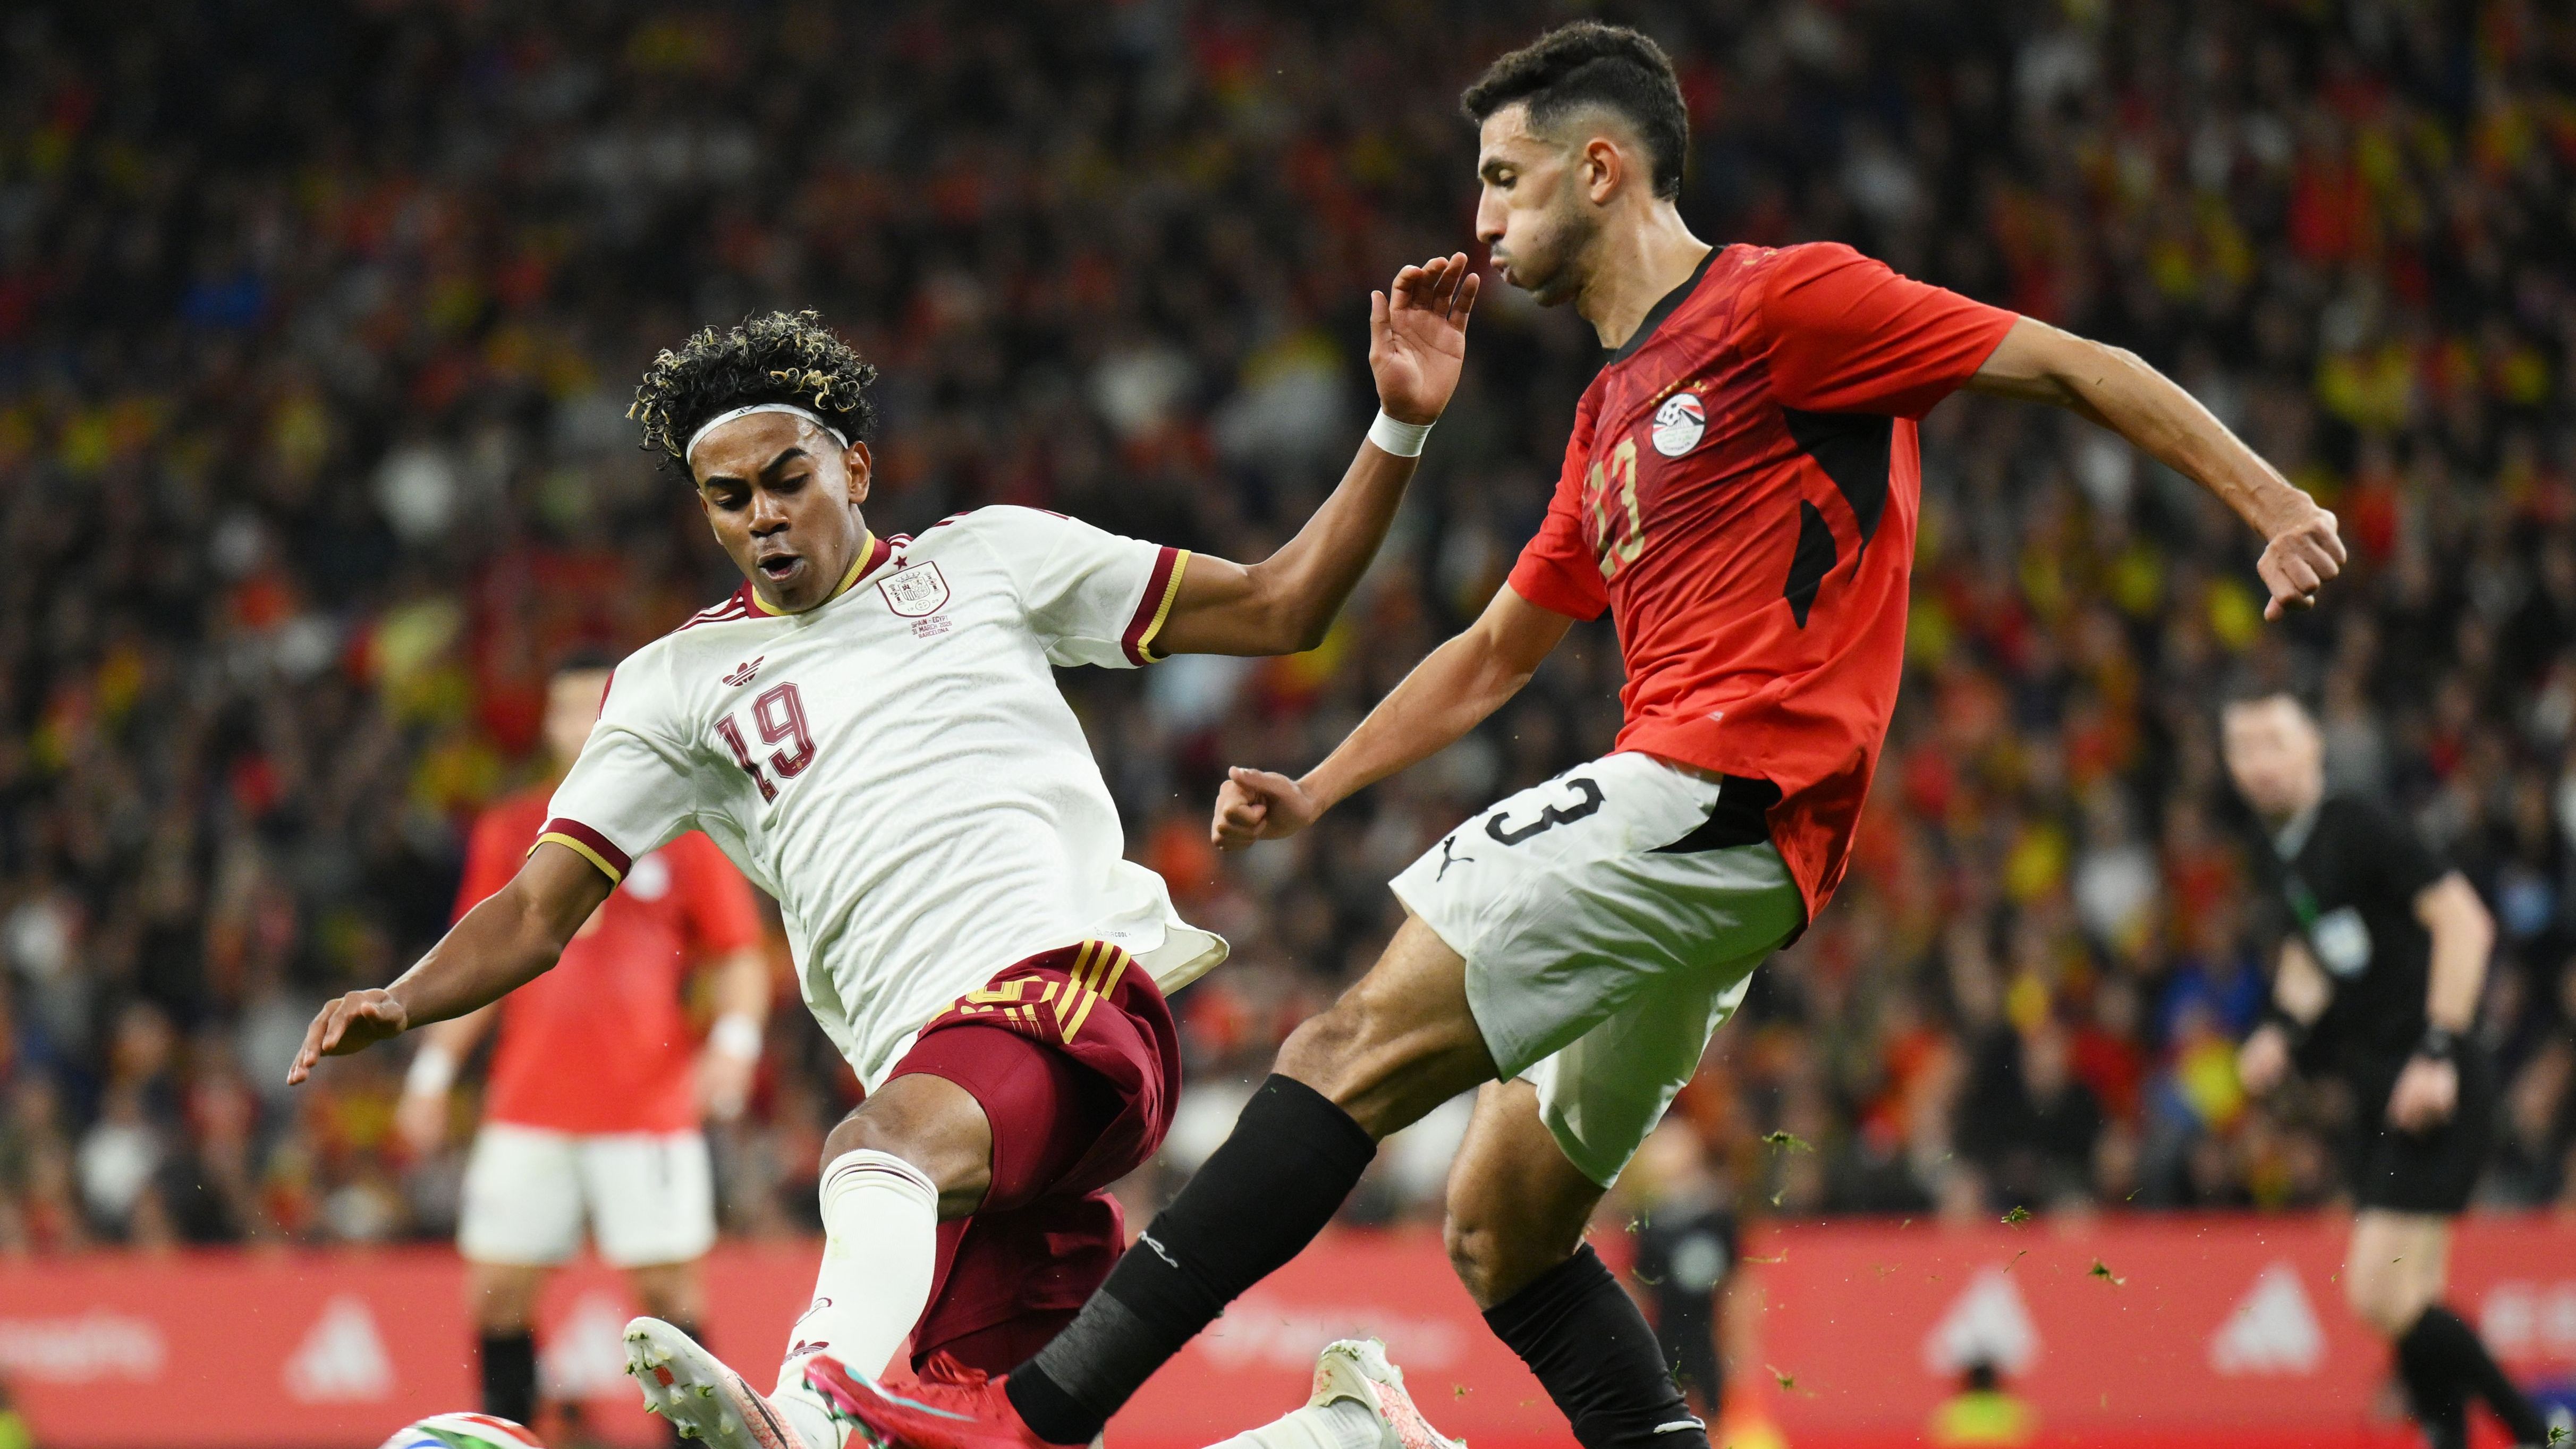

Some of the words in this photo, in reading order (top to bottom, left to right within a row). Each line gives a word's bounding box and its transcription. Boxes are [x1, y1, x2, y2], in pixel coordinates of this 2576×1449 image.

[911, 618, 927, 628] SPAIN
[919, 624, 938, 632] MARCH
[918, 628, 949, 639] BARCELONA
[714, 682, 817, 806] 19
